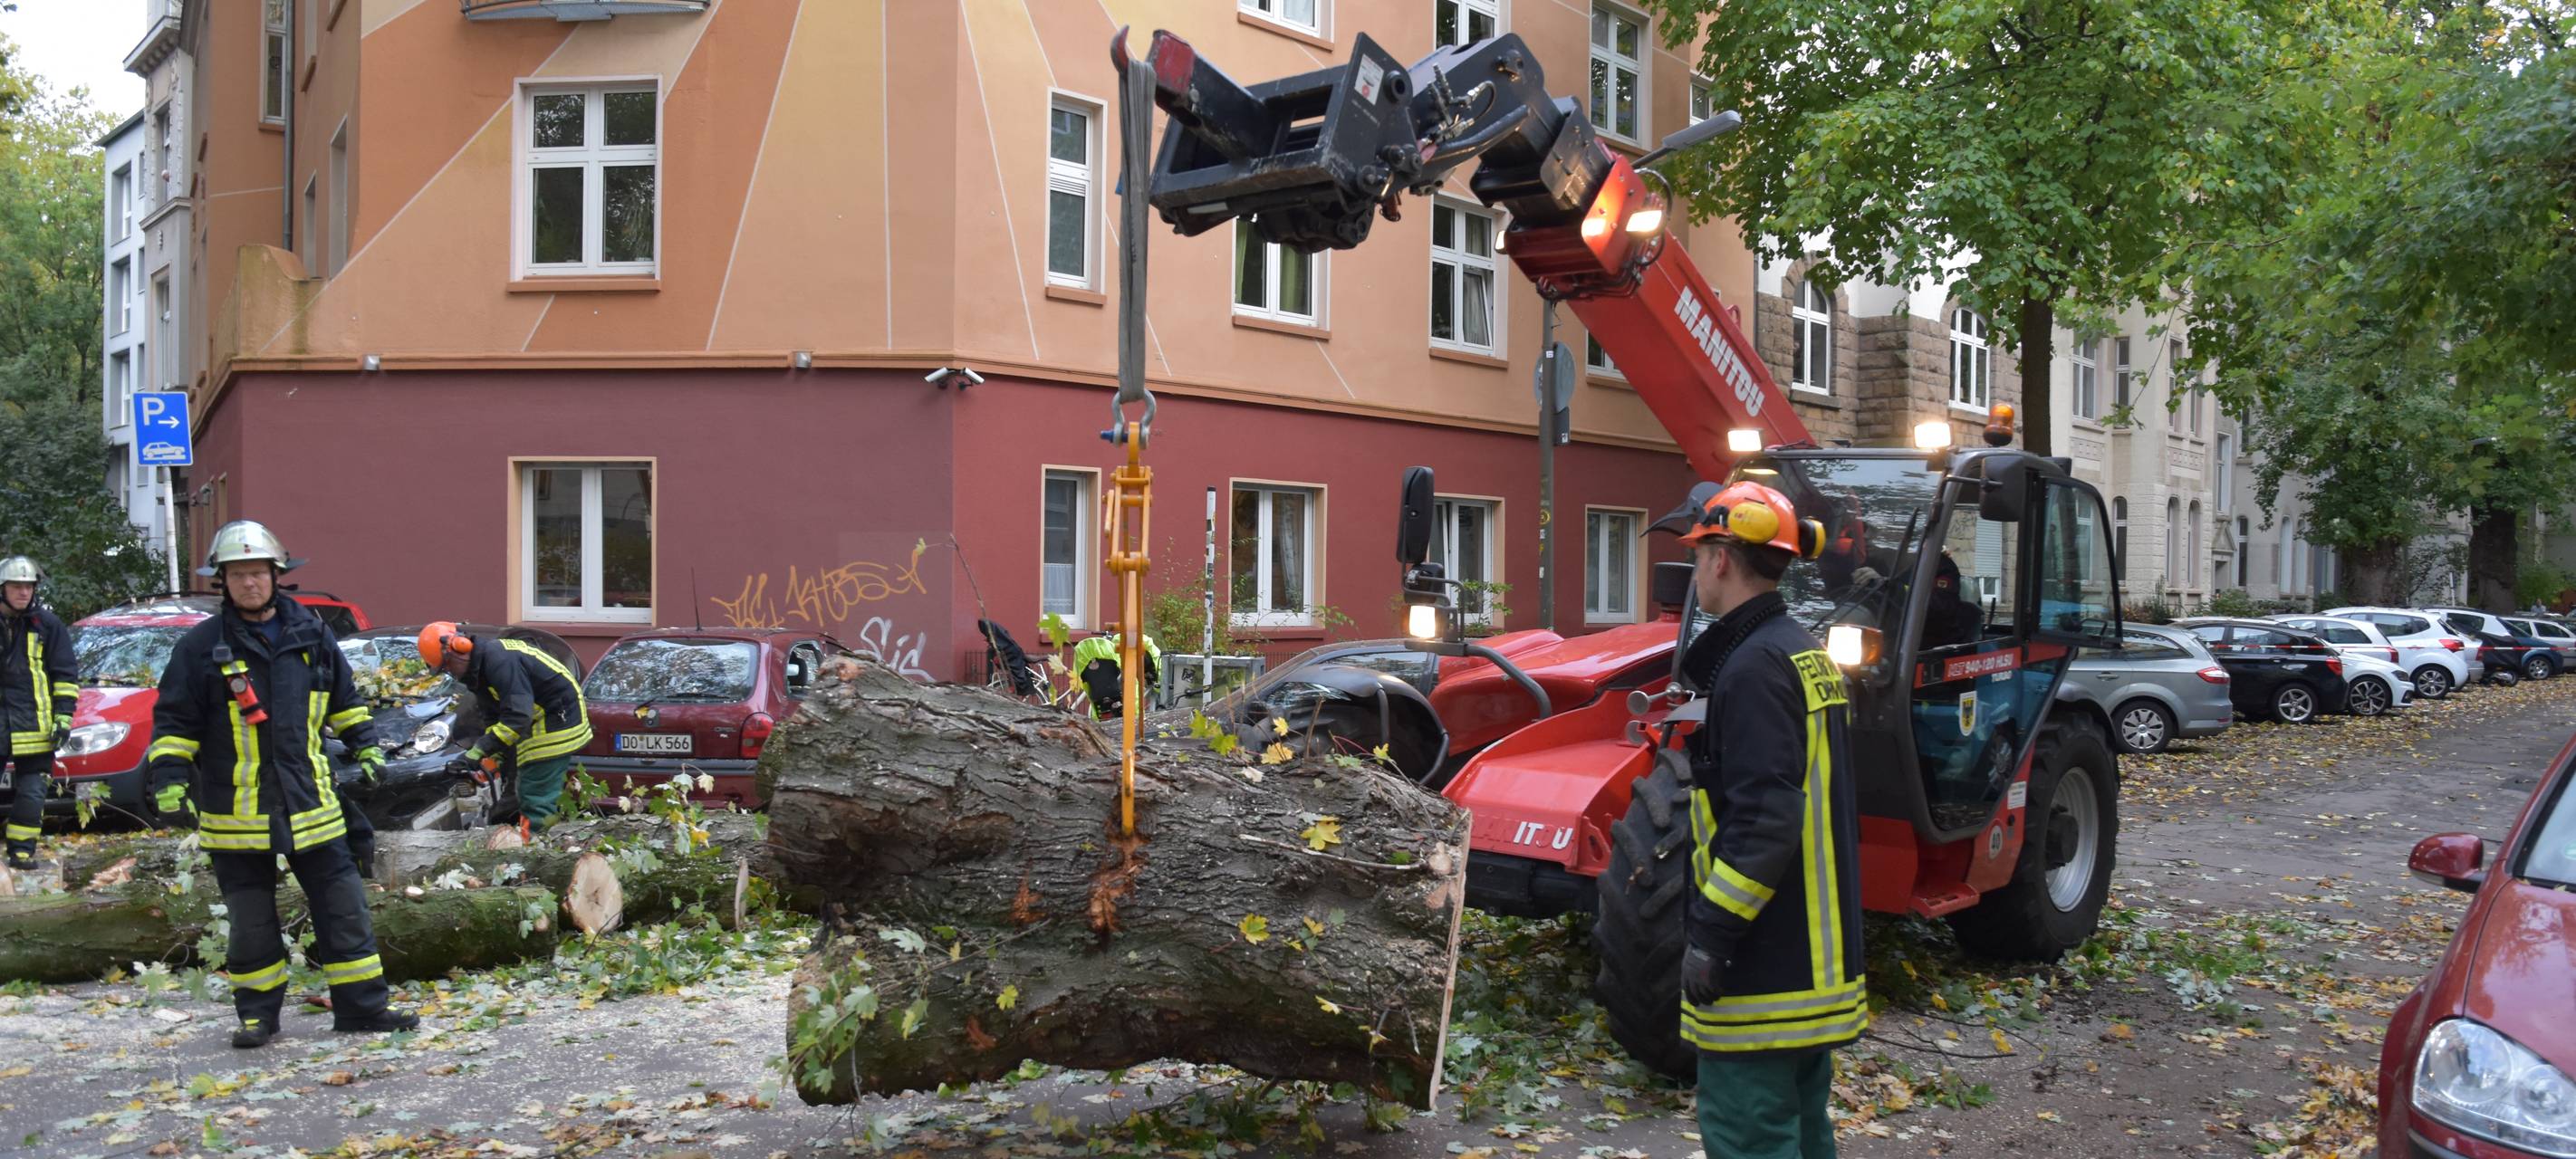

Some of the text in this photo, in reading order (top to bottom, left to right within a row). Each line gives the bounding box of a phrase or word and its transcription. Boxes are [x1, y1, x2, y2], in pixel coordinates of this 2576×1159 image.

[1674, 285, 1765, 417] MANITOU
[142, 397, 165, 426] P
[622, 736, 689, 750] DO LK 566
